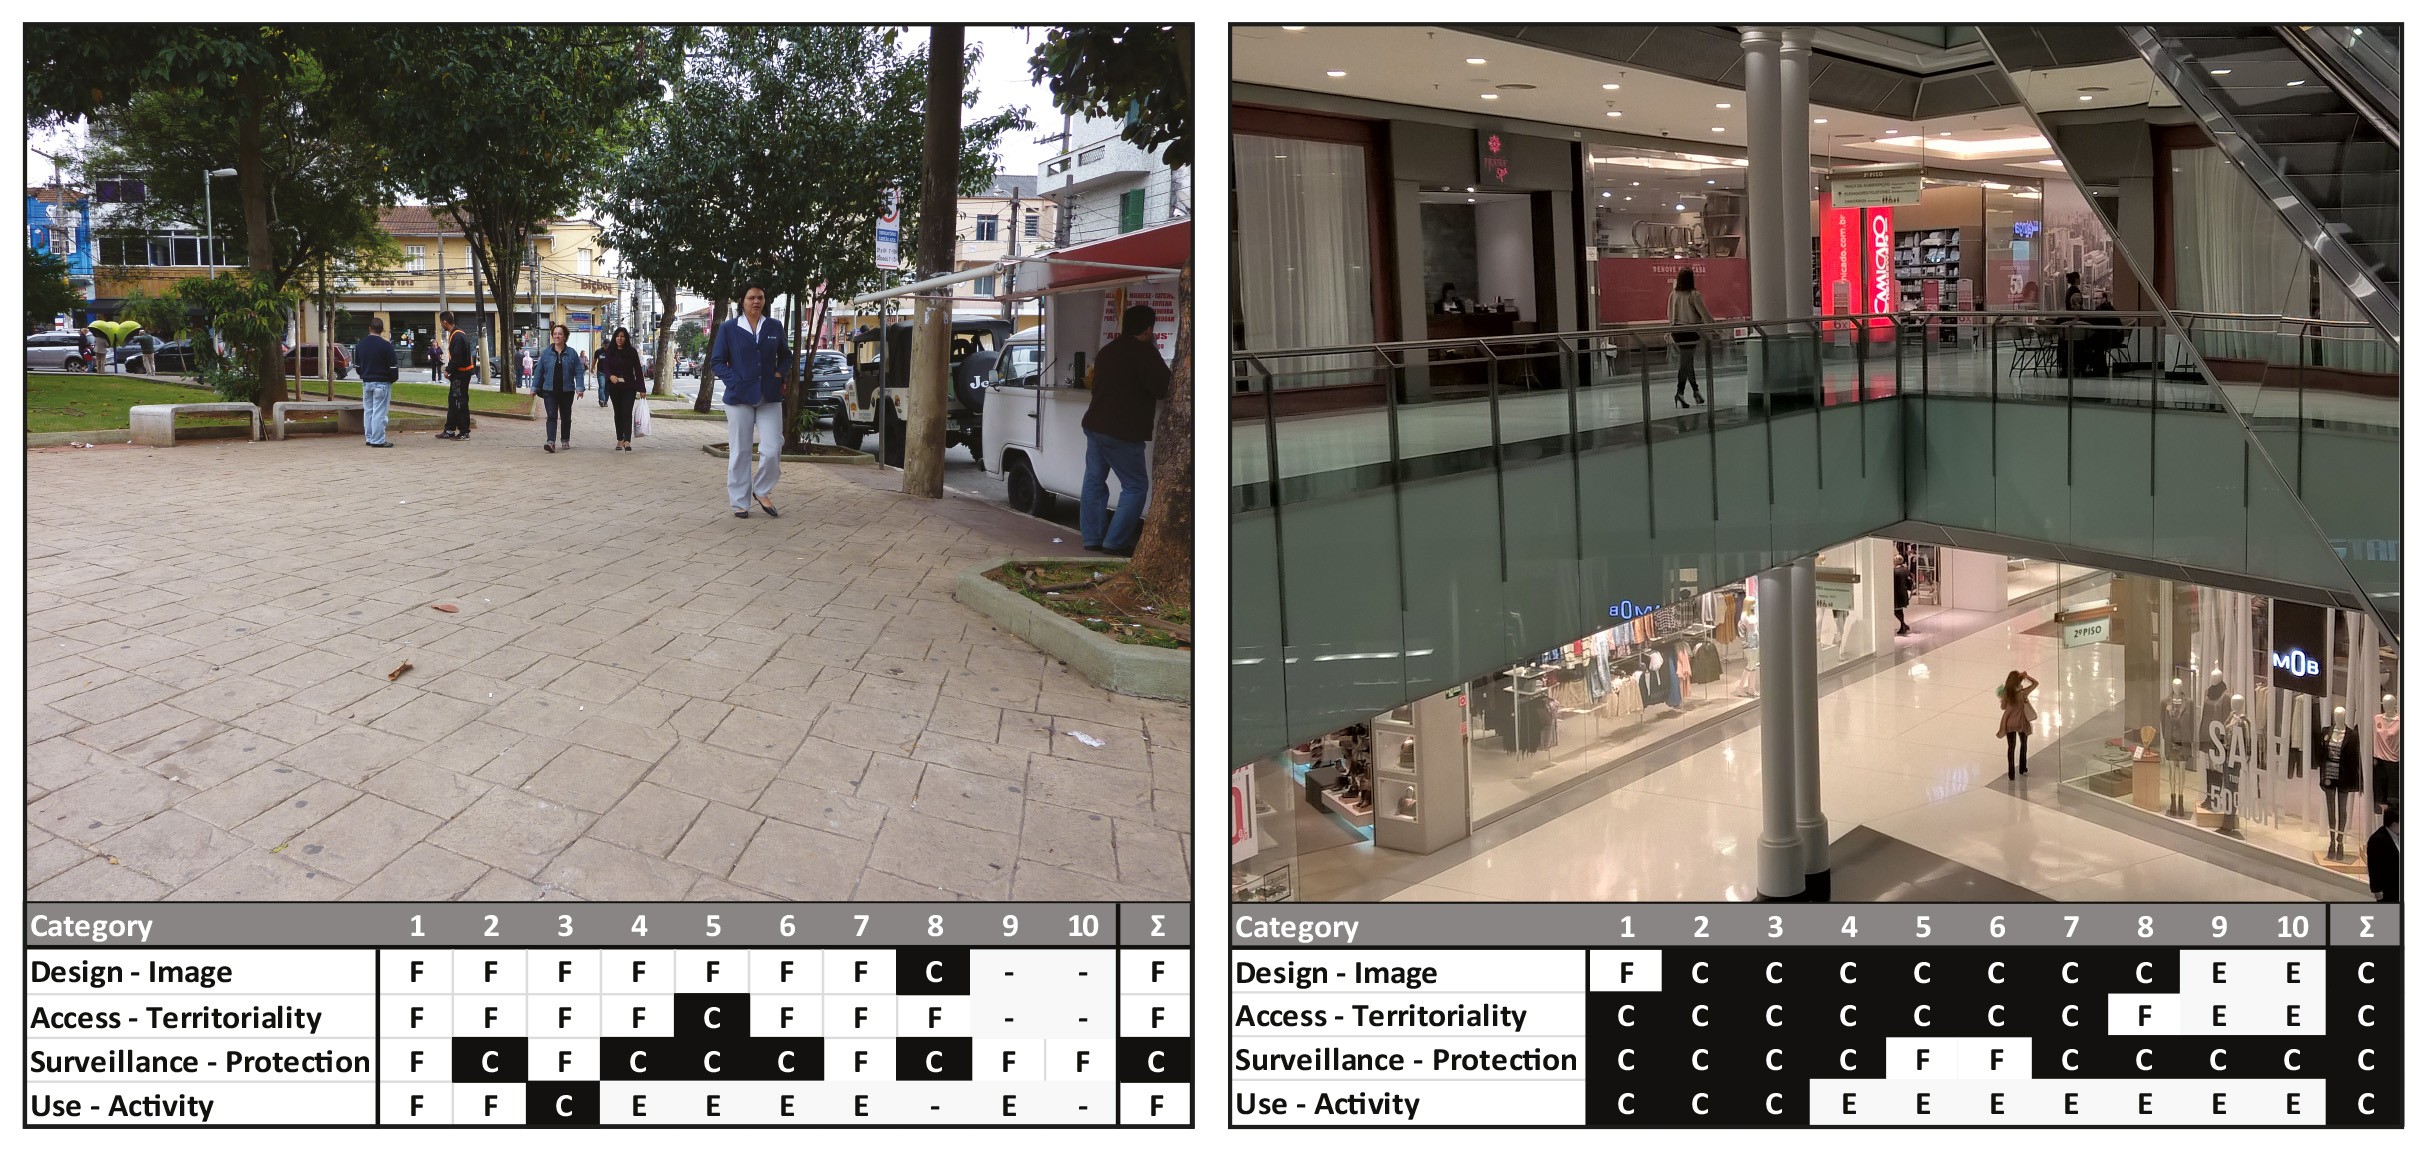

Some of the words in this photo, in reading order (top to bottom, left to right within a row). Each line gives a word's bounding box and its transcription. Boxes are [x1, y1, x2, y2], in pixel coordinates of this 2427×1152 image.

[1873, 215, 1887, 314] CAMICADO
[2083, 625, 2102, 636] PISO
[2272, 650, 2320, 677] MOB
